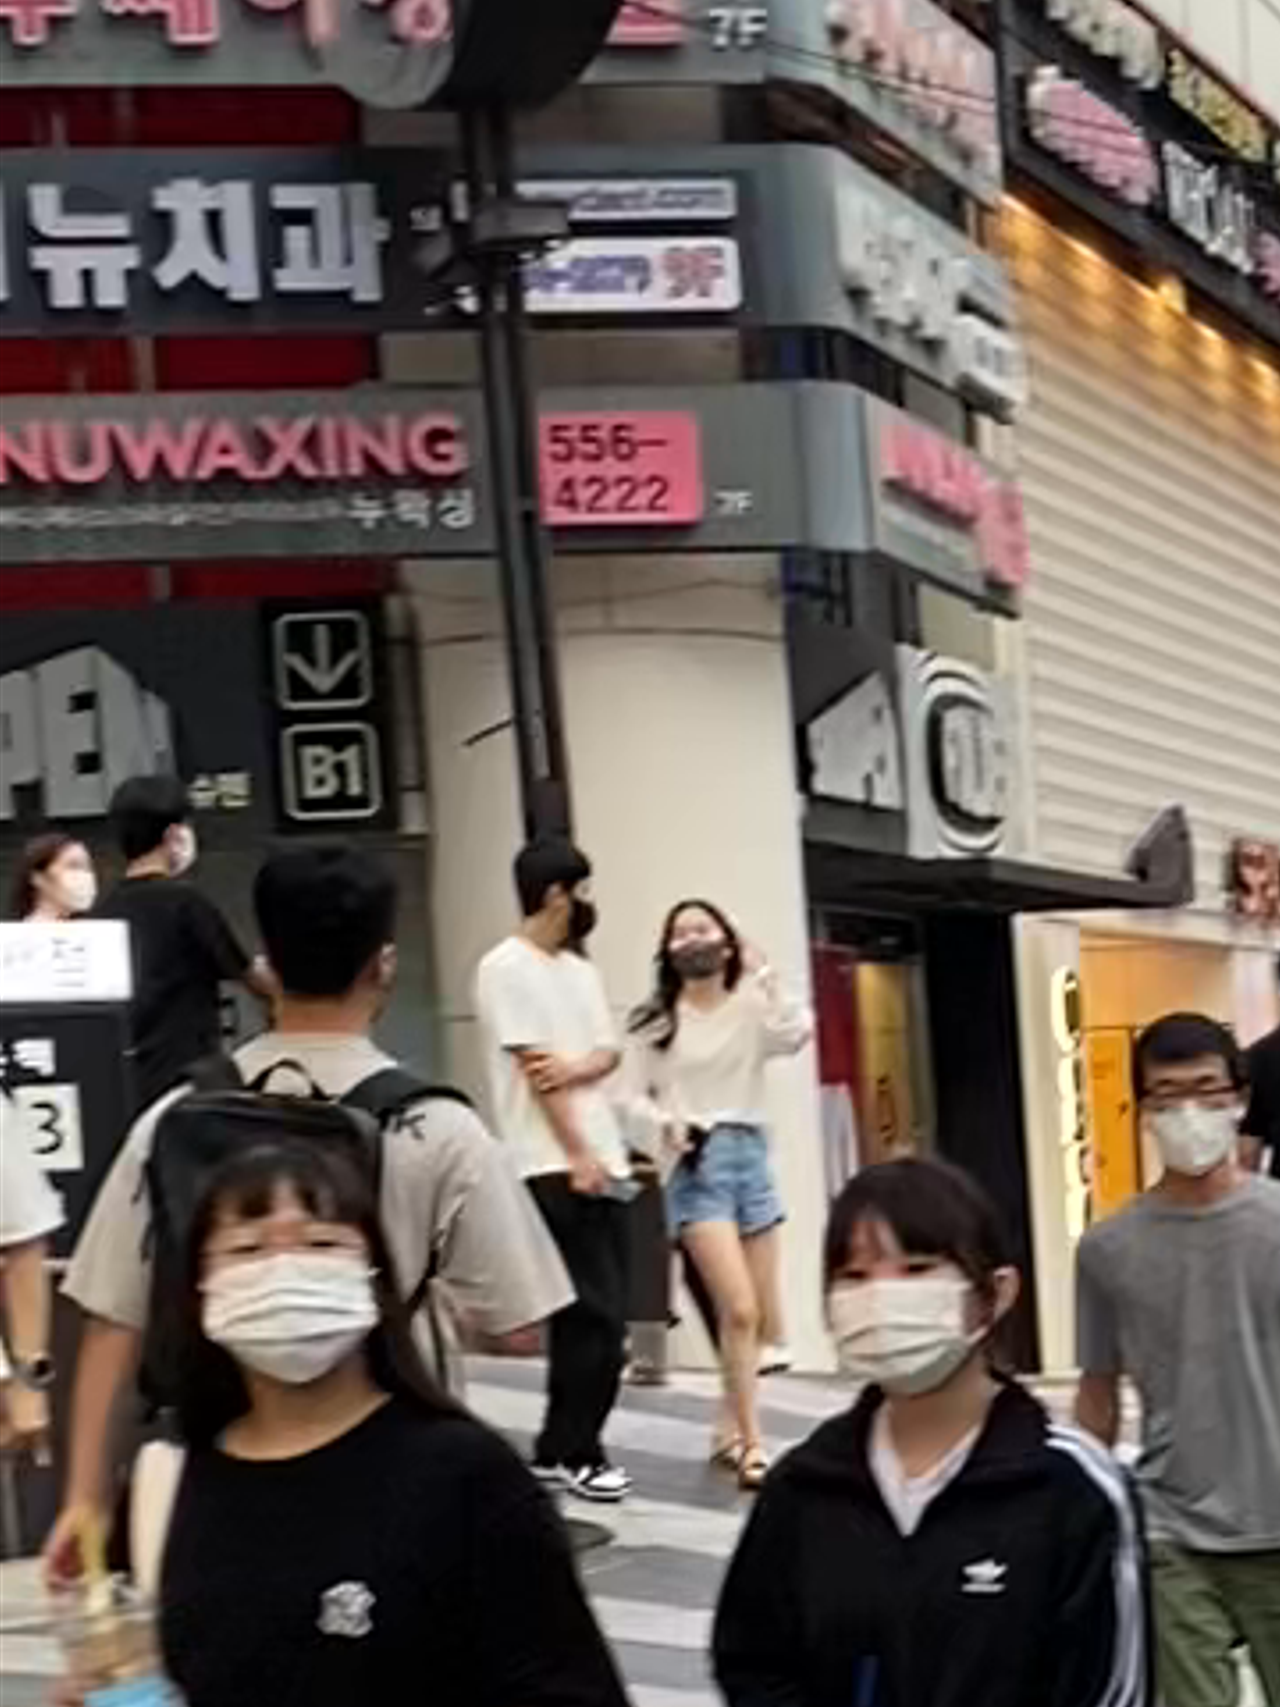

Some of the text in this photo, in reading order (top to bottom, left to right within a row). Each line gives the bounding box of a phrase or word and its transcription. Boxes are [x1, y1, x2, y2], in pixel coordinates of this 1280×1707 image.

[708, 7, 768, 50] 7F
[0, 178, 390, 310] 뉴치과
[0, 410, 469, 484] NUWAXING
[548, 424, 668, 463] 556-
[553, 475, 669, 514] 4222
[300, 744, 365, 799] B1
[30, 1100, 63, 1156] 3
